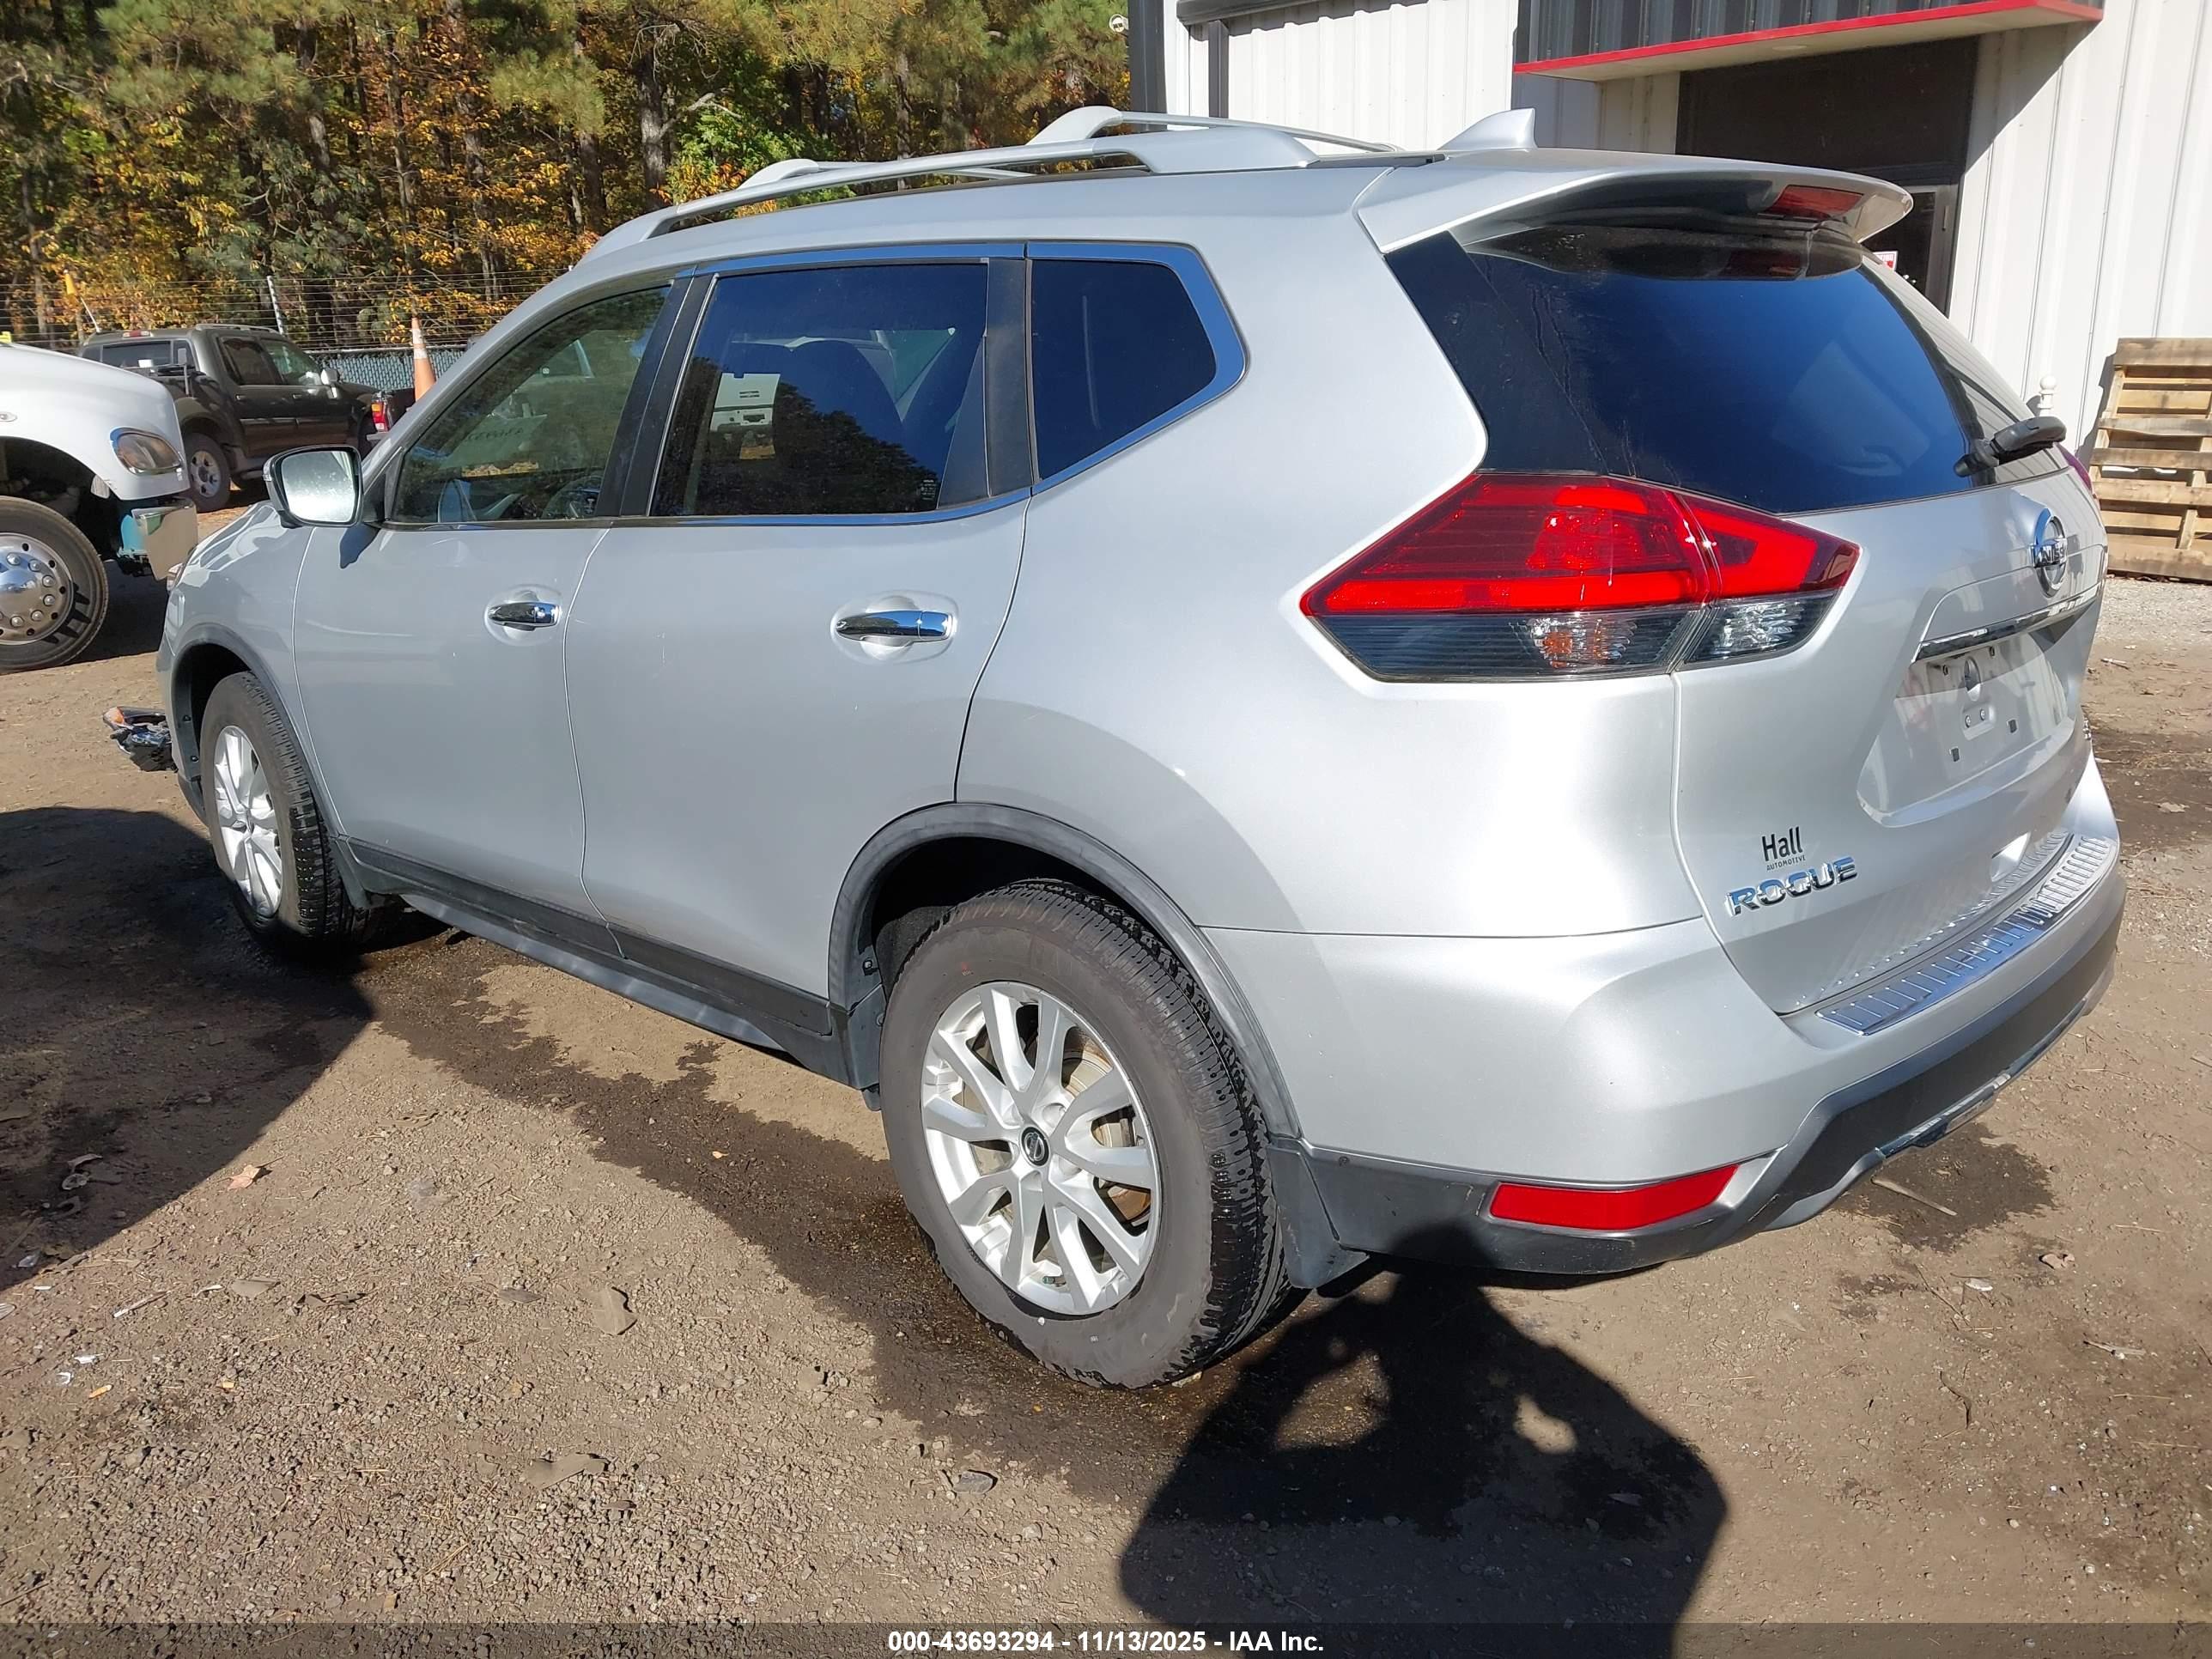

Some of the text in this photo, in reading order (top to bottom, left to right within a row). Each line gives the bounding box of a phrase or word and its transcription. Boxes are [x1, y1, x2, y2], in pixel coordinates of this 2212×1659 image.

[1761, 826, 1803, 862] Hall
[1765, 854, 1806, 872] AUTOMOTIVE
[1724, 856, 1858, 916] ROGUE
